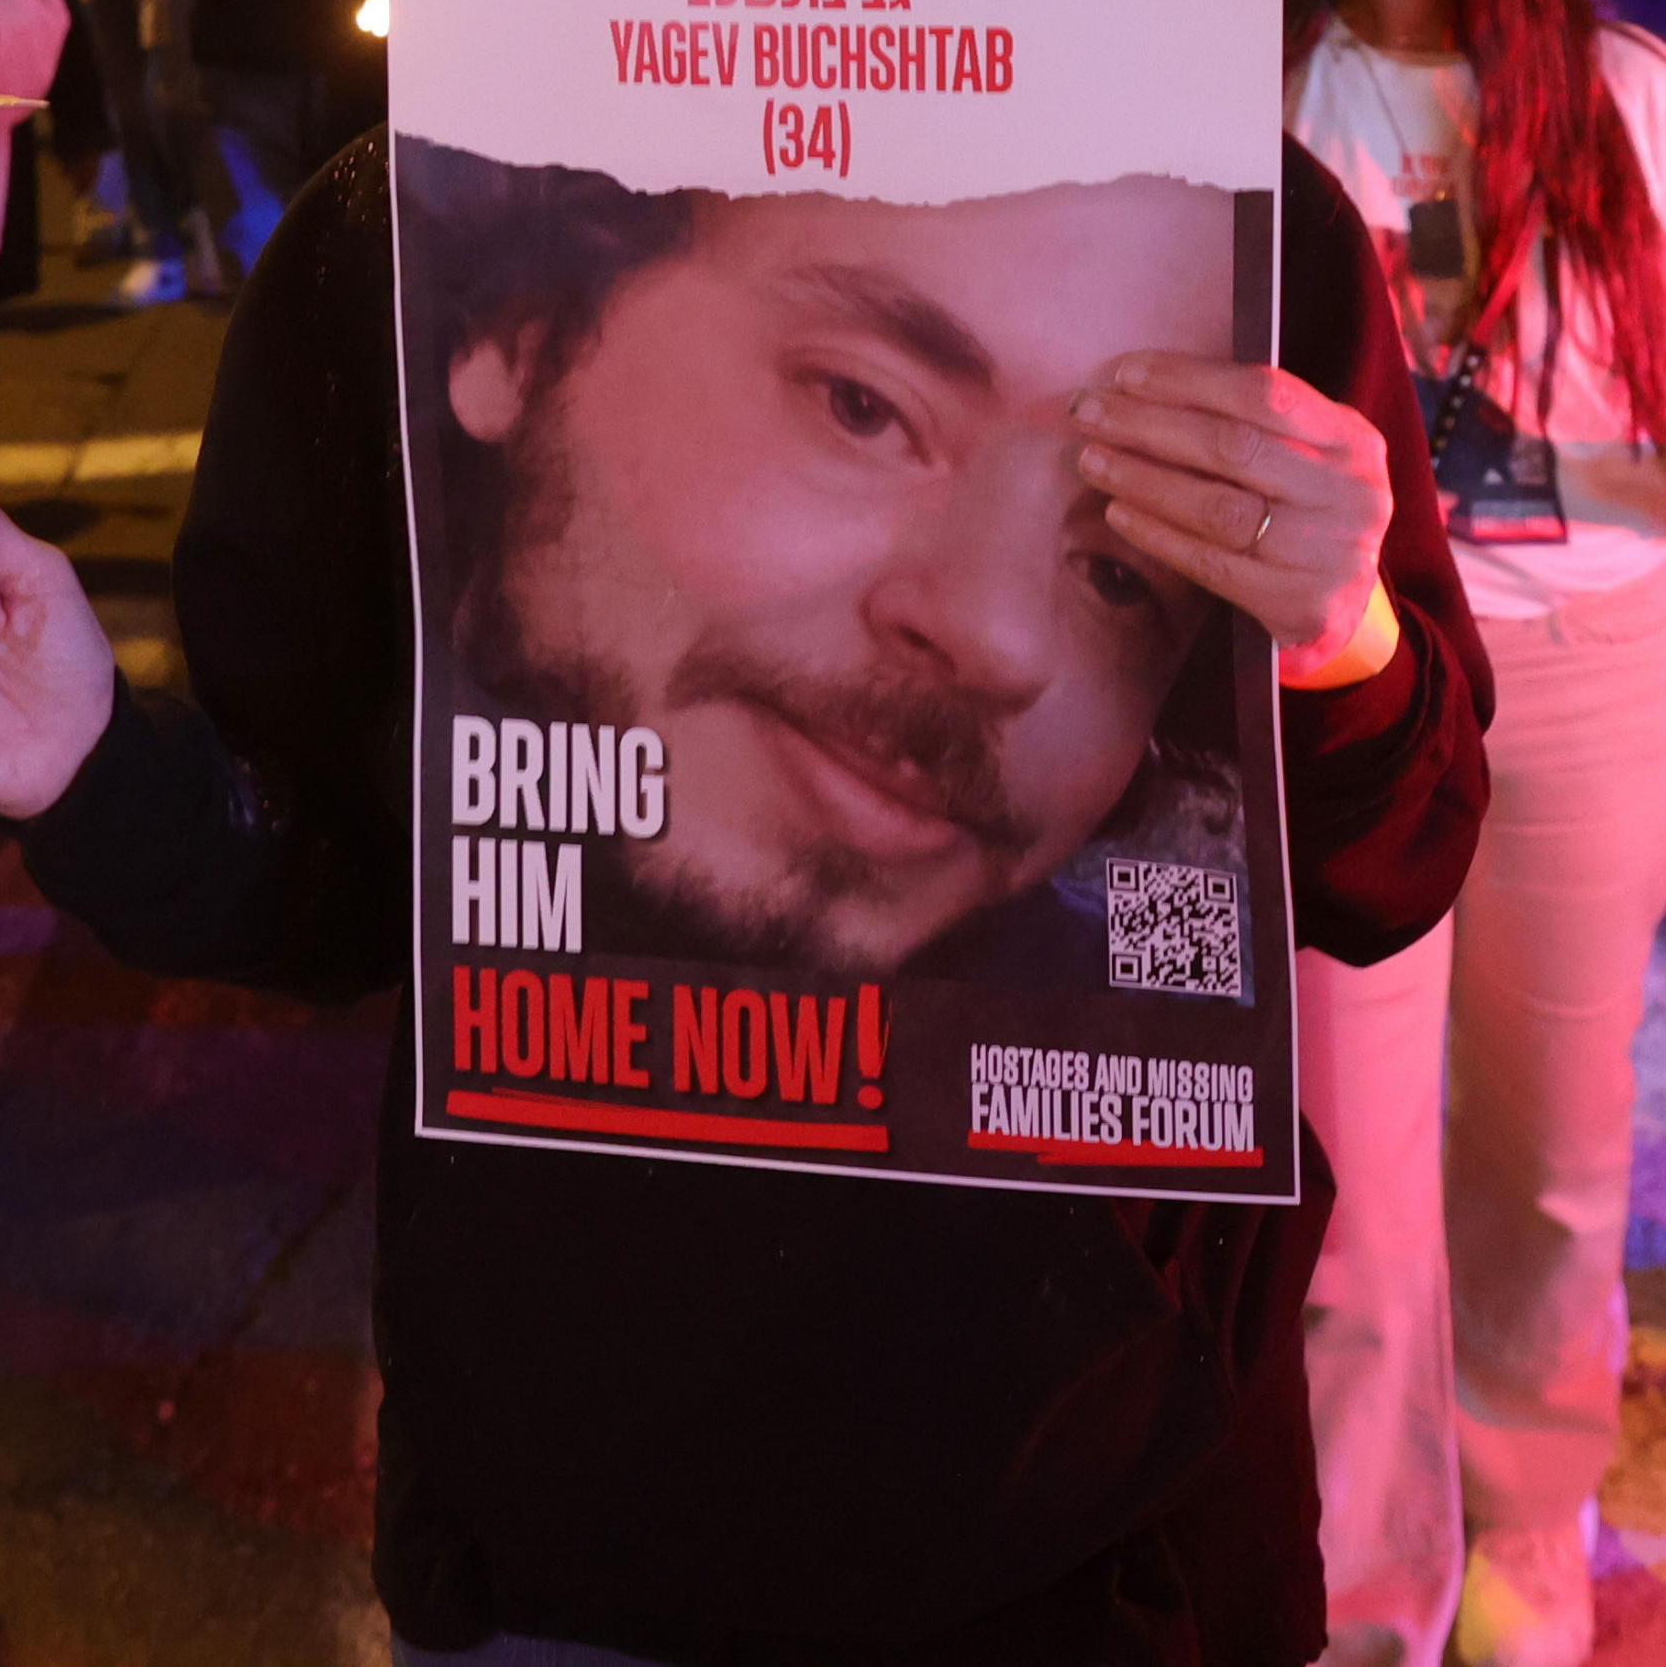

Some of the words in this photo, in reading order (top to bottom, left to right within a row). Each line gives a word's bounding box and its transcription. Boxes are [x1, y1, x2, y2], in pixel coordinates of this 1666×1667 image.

[610, 20, 739, 86] YAGEV
[754, 22, 1014, 93] BUCHSHTAB
[763, 98, 851, 179] (34)
[451, 714, 665, 839] BRING
[451, 835, 582, 954] HIM
[452, 964, 650, 1089] HOME
[673, 982, 890, 1110] NOW!
[970, 1043, 1090, 1091] HOSTAGES
[1094, 1053, 1142, 1096] AND
[1147, 1058, 1254, 1104] MISSING
[971, 1082, 1123, 1145] FAMILIES
[1131, 1095, 1255, 1153] FORUM
